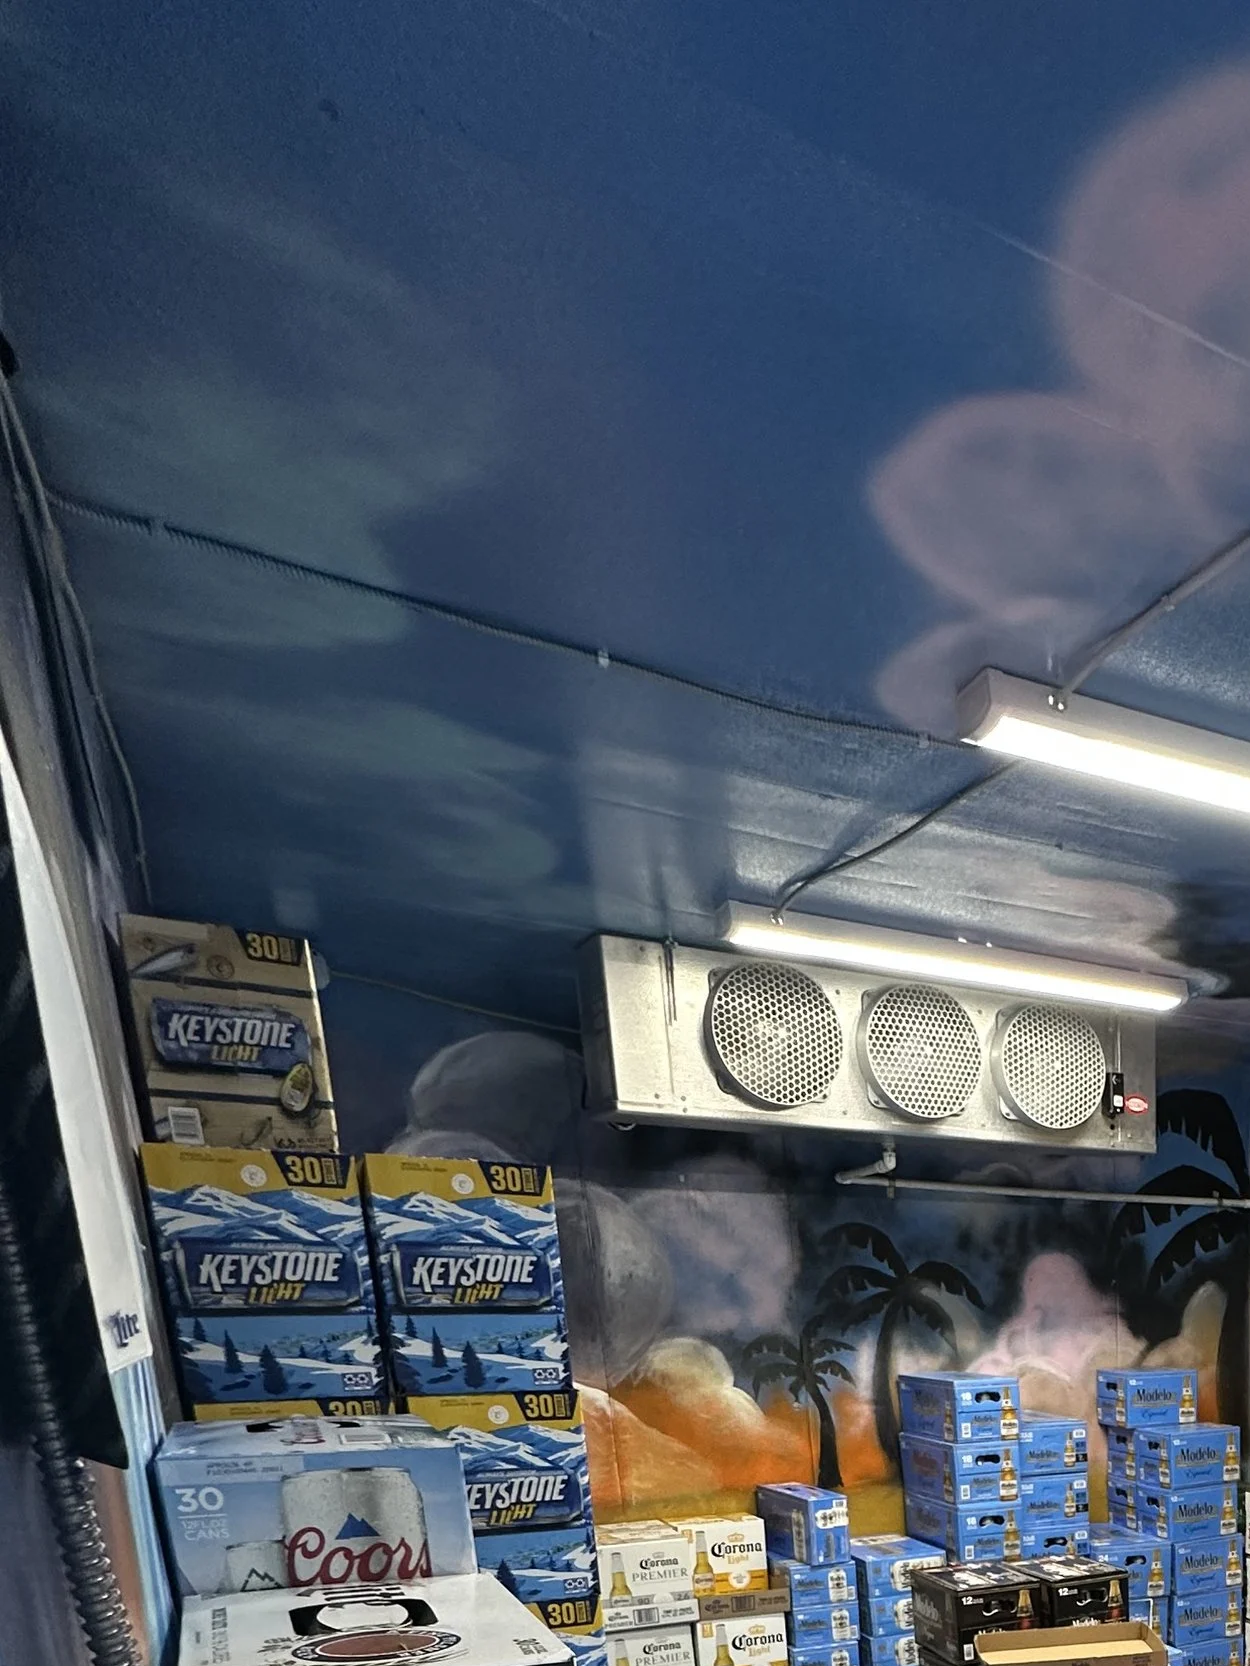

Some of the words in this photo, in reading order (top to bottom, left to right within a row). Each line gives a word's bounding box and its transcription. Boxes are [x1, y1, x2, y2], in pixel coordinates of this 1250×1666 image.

[167, 1012, 296, 1048] KEYSTONE
[199, 1251, 343, 1293] KEYSTONE
[411, 1254, 538, 1293] KEYSTONE
[1135, 1388, 1175, 1401] Modelo
[1179, 1448, 1217, 1462] Modelo
[1176, 1504, 1214, 1518] Modelo
[183, 1530, 231, 1542] CANS
[711, 1541, 762, 1558] Corona
[287, 1526, 433, 1589] Coors
[640, 1557, 679, 1570] Corona
[1185, 1555, 1219, 1570] Modelo
[632, 1567, 688, 1582] PREMIER
[1058, 1588, 1069, 1596] 12
[960, 1596, 973, 1605] 12
[1183, 1608, 1219, 1622] Modelo
[643, 1641, 681, 1655] Corona
[732, 1631, 784, 1651] Corona
[635, 1651, 691, 1666] PREMIER
